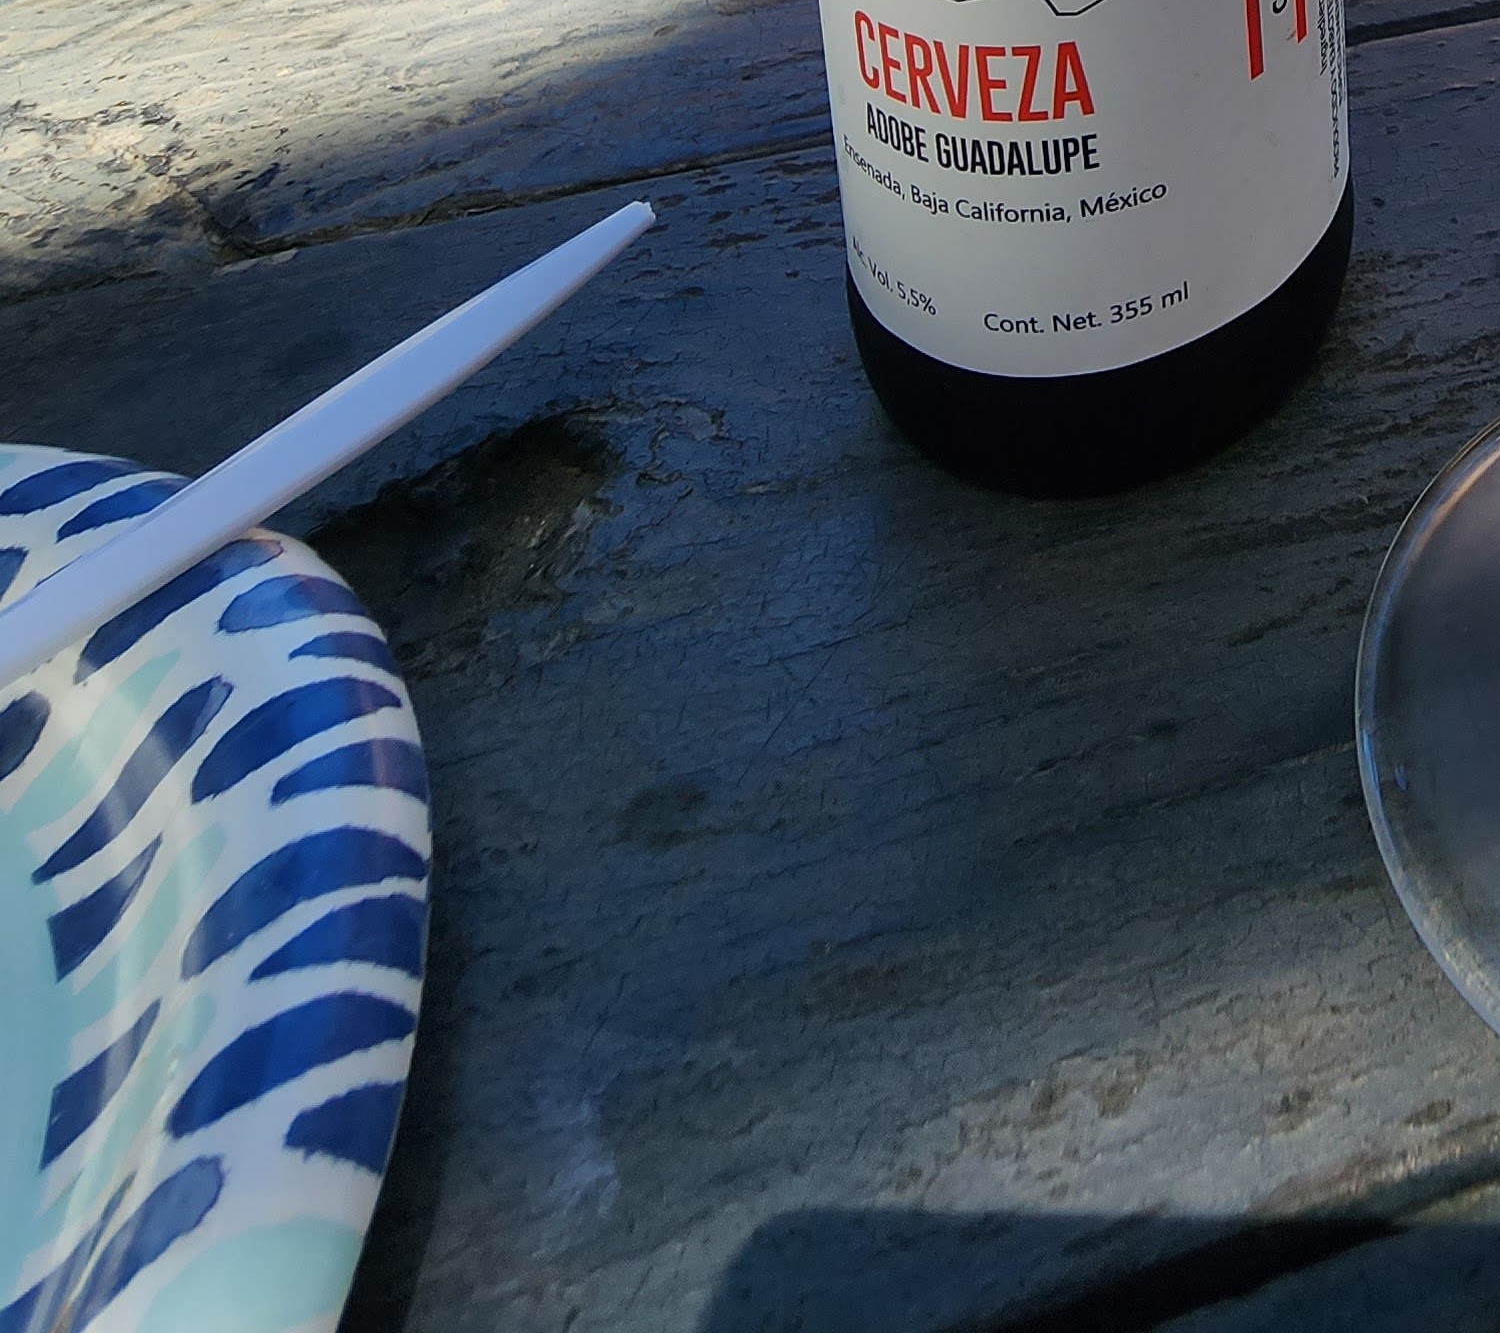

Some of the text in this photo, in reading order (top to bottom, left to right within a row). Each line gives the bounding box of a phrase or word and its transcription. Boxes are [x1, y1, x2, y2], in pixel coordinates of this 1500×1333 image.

[854, 9, 1096, 123] CERVEZA
[866, 101, 1100, 176] ADOBE GUADALUPE
[843, 133, 1167, 223] Ensenada, Baja California, México
[868, 256, 893, 293] Vol.
[896, 280, 937, 316] 5,5%
[983, 280, 1190, 334] Cont. Net. 355 ml
